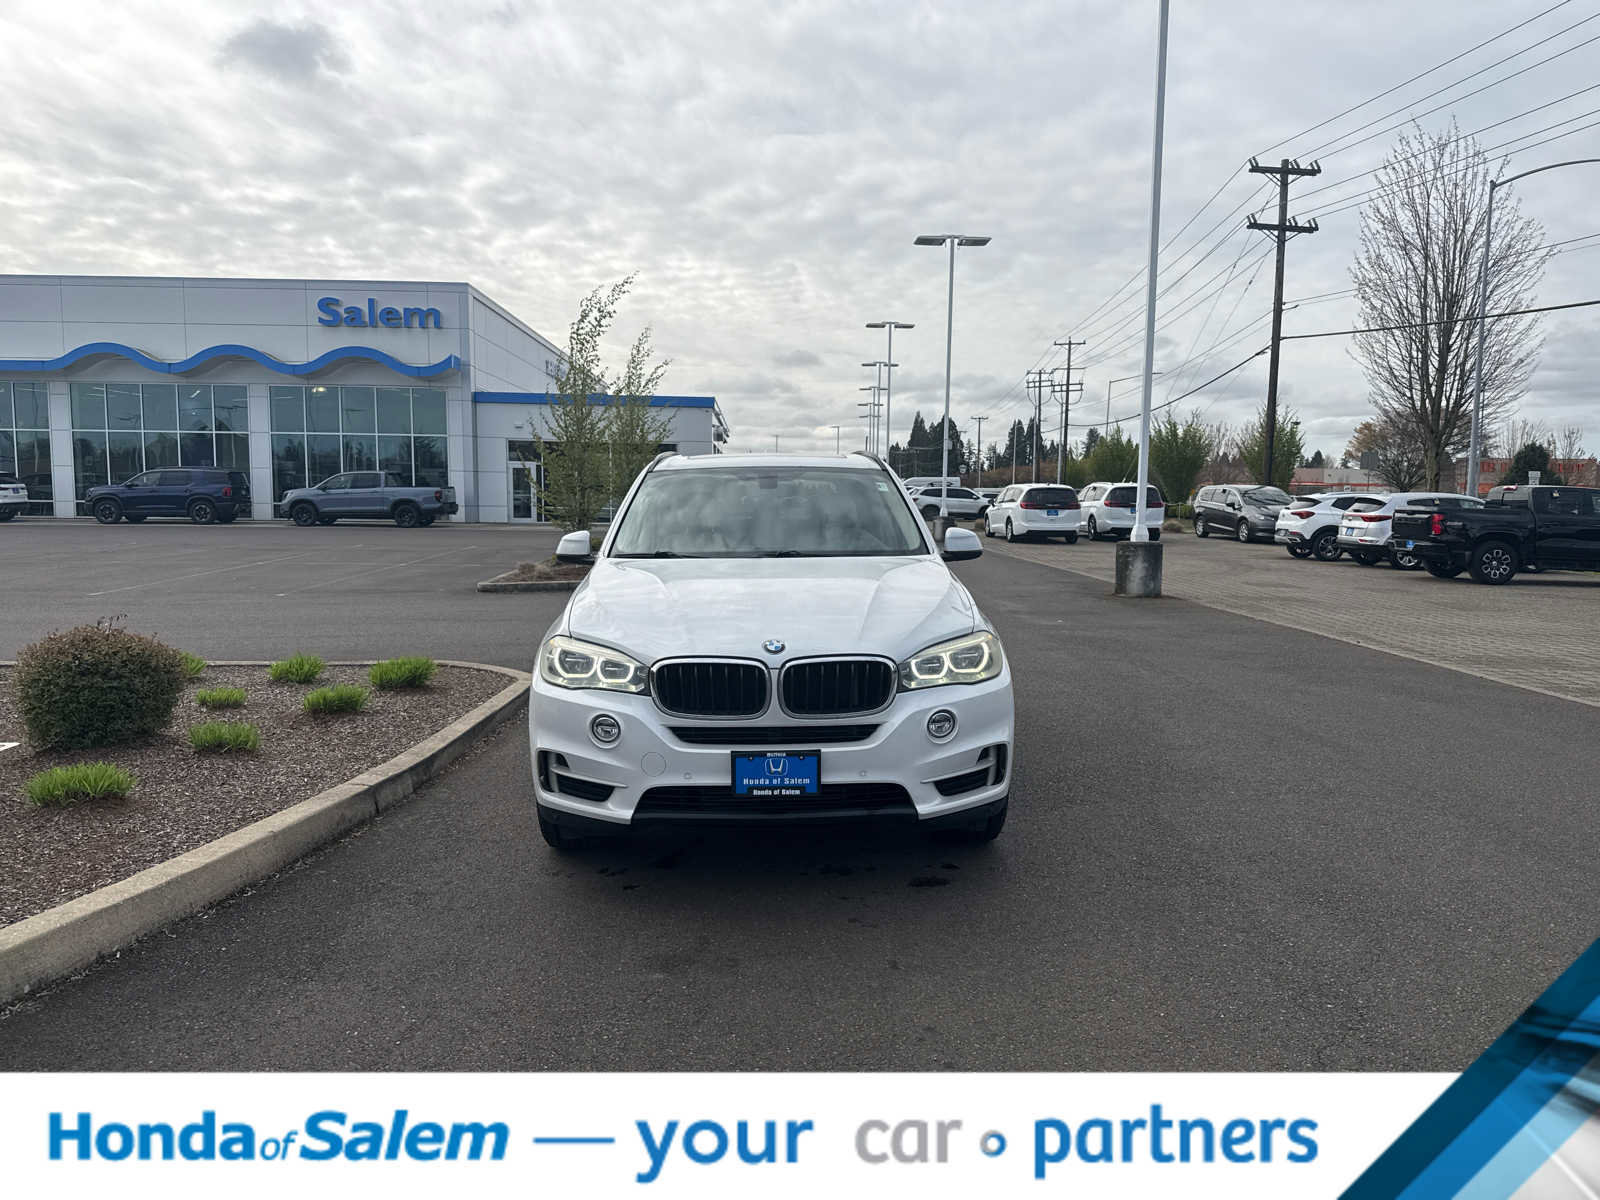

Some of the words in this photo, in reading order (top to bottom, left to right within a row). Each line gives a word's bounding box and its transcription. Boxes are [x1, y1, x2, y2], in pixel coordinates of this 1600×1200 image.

[316, 296, 442, 328] Salem
[743, 777, 770, 785] Honda
[772, 777, 781, 785] of
[783, 777, 810, 785] Salem
